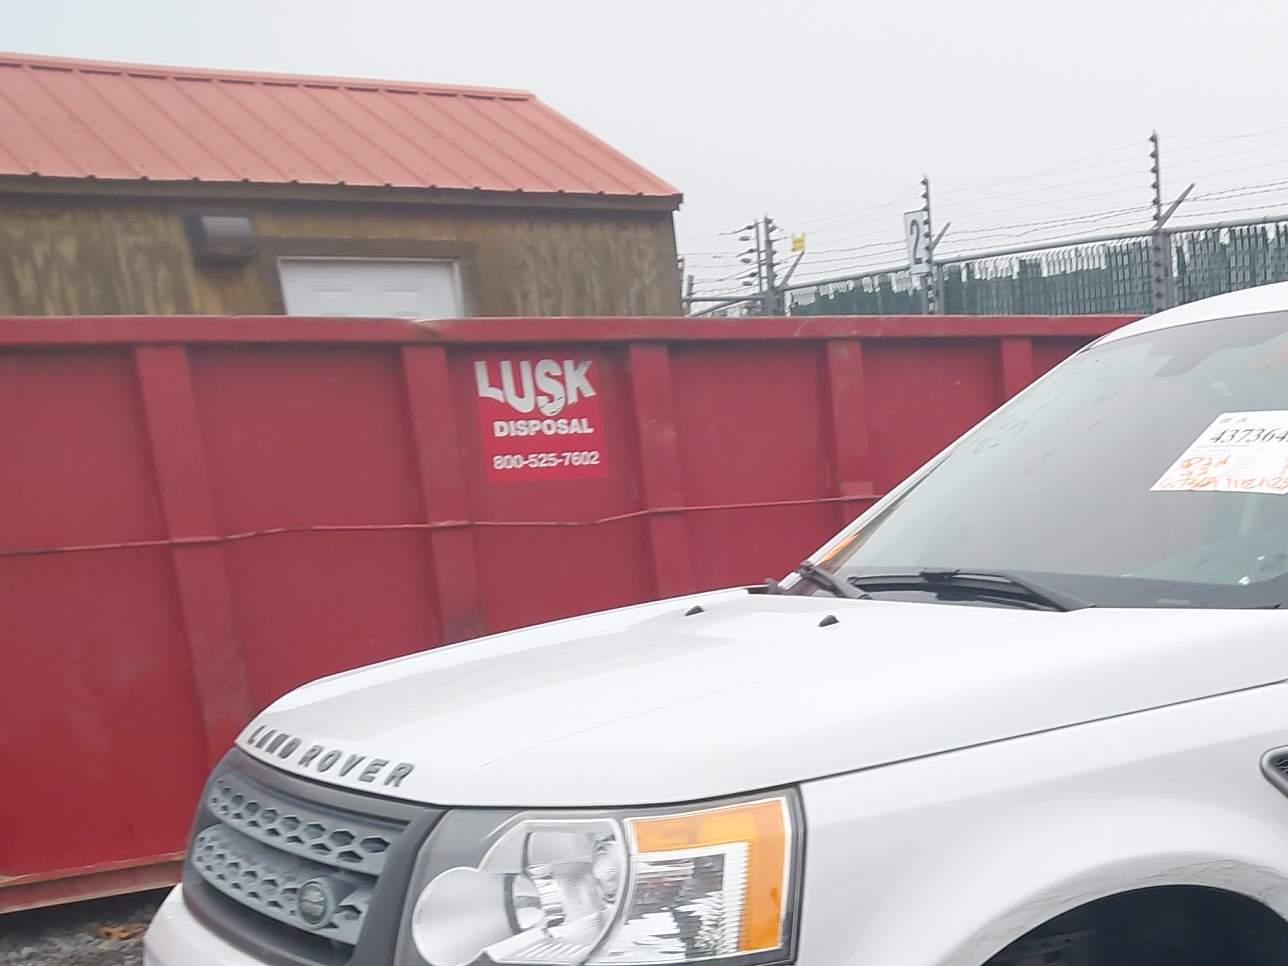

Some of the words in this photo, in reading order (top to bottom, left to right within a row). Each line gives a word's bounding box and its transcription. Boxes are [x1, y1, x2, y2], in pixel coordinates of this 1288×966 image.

[473, 359, 597, 416] LUSK
[493, 418, 595, 437] DISPOSAL
[492, 451, 601, 470] 800-525-7602
[247, 724, 302, 760] LAND
[298, 744, 415, 788] ROVER
